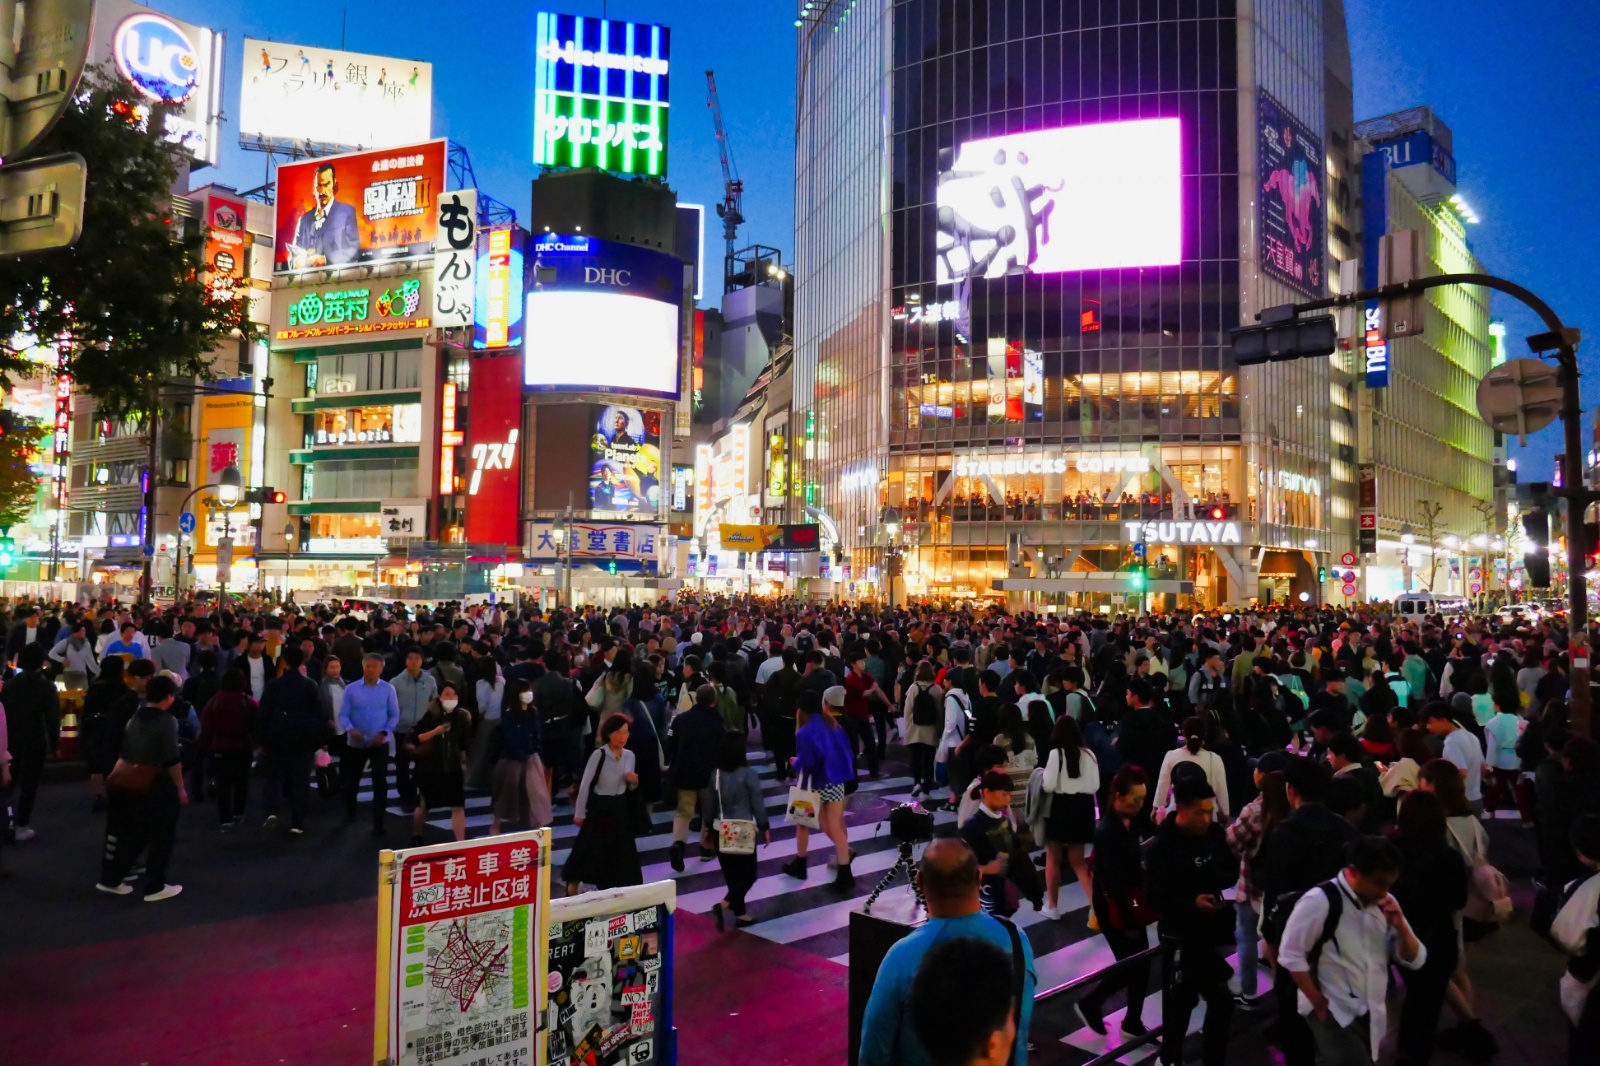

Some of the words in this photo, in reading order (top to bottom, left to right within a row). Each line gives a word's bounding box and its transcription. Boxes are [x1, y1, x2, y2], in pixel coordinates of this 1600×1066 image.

[270, 57, 405, 100] フラリ銀座
[543, 115, 663, 151] サロンパス
[364, 185, 386, 203] RED
[387, 181, 416, 200] DEAD
[364, 199, 416, 216] REDEMPTION
[535, 243, 554, 252] DHC
[554, 242, 589, 252] Channel
[438, 194, 473, 322] もんじゃ
[584, 267, 631, 287] DHC
[324, 299, 369, 322] 西村
[317, 428, 390, 446] Euphoria
[604, 449, 647, 463] Planets
[956, 458, 1066, 476] STARBUCKS
[1076, 457, 1150, 473] COFFEE
[1362, 516, 1374, 527] 本
[1125, 521, 1241, 543] TSUTAYA
[409, 846, 532, 887] 自転車等
[609, 915, 626, 928] WILD
[608, 925, 629, 938] HERO
[633, 1001, 652, 1010] THAT
